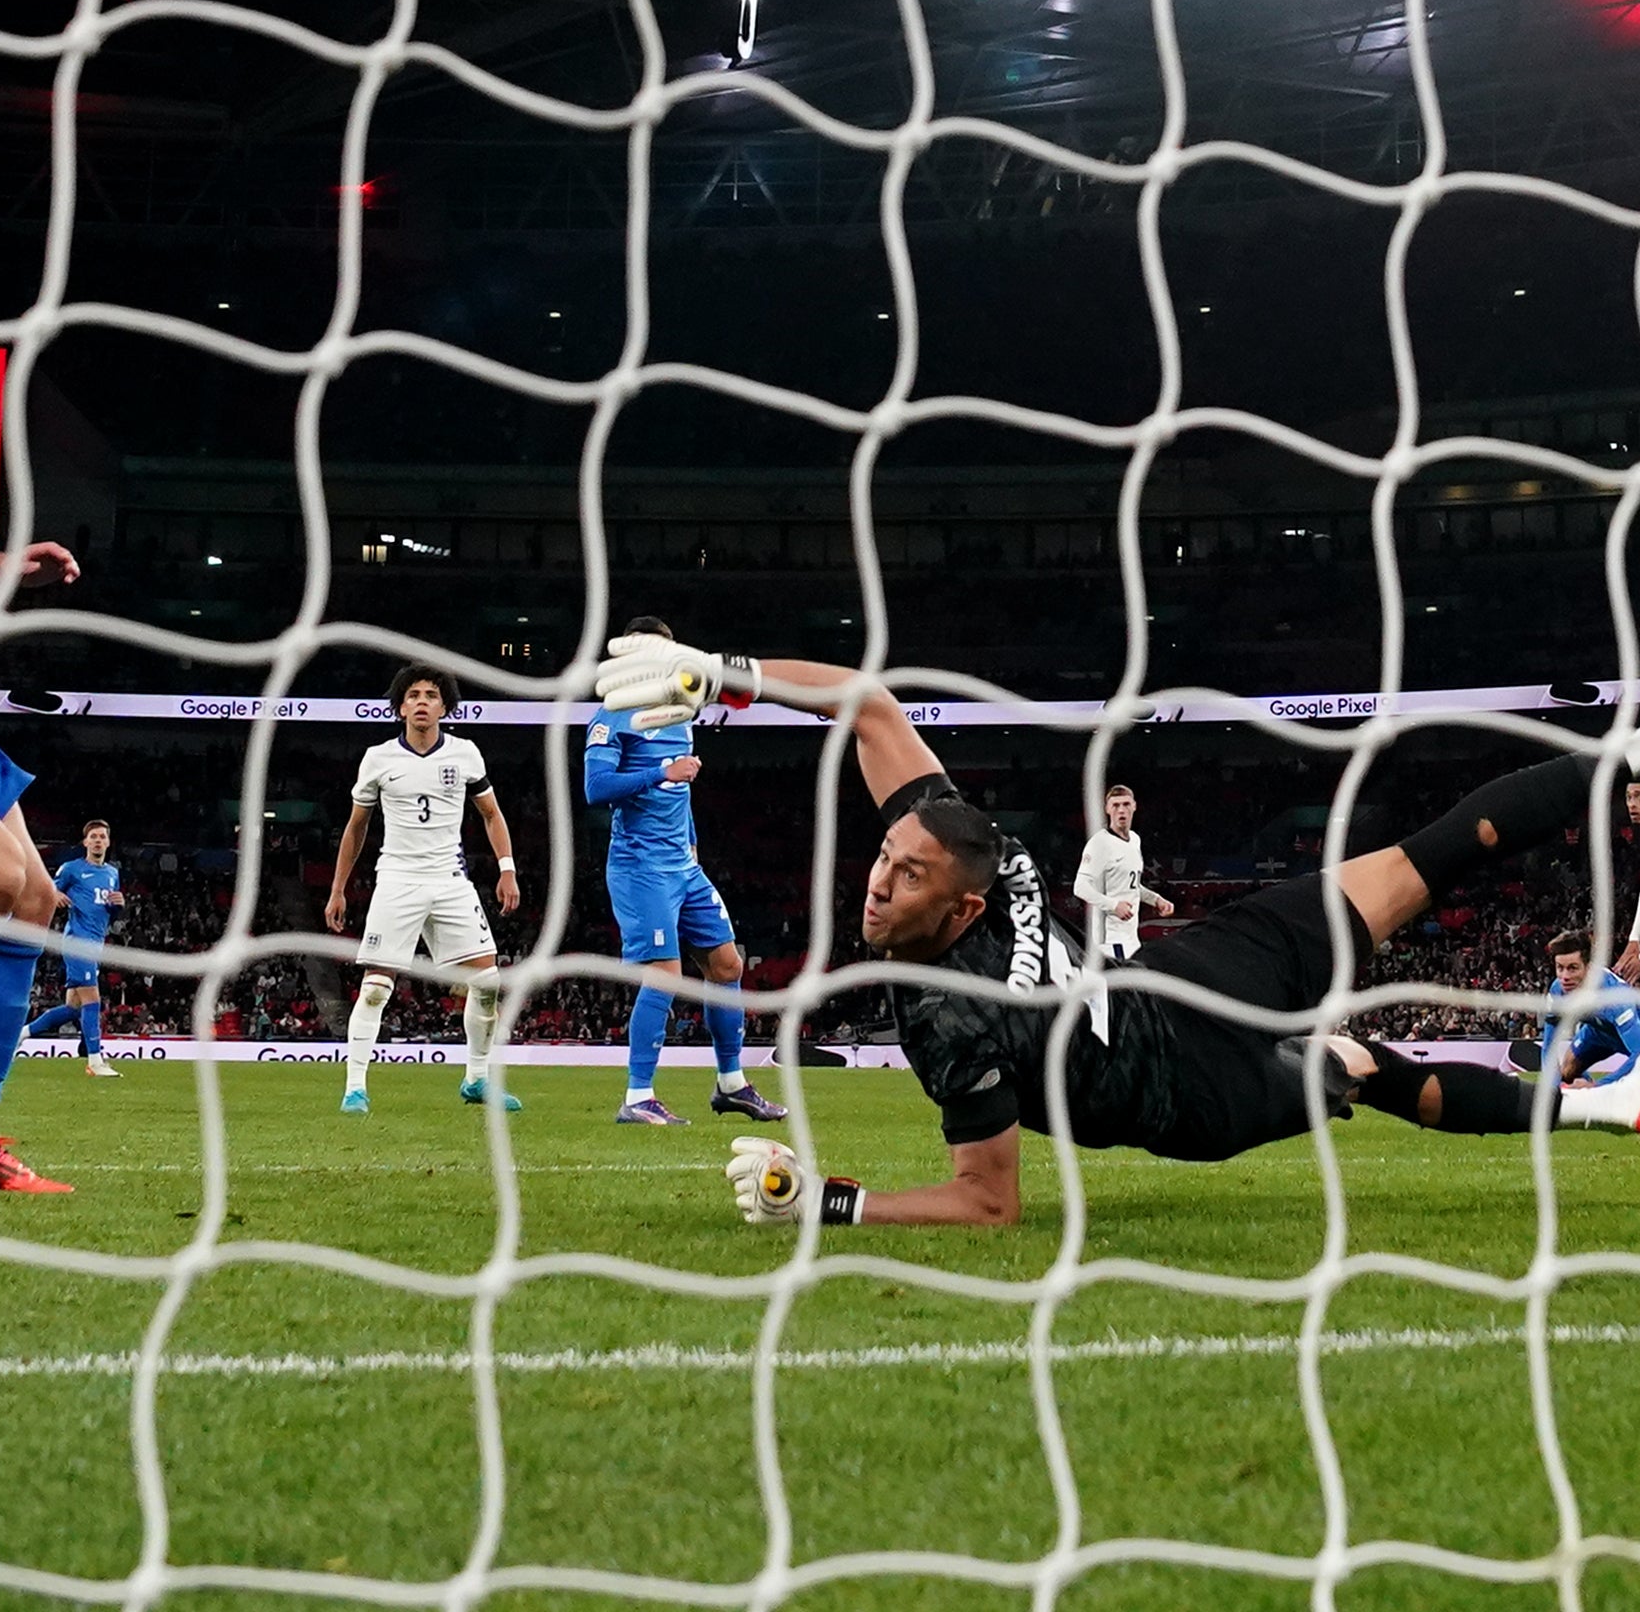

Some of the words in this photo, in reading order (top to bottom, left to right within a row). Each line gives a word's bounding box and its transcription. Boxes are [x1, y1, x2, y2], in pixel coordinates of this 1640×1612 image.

[180, 699, 246, 719] Google
[297, 702, 308, 717] 9
[355, 703, 396, 719] Goo
[473, 705, 483, 719] 9
[930, 707, 940, 721] 9
[1270, 700, 1333, 719] Google
[1338, 697, 1376, 713] Pixel
[417, 795, 431, 823] 3
[474, 905, 488, 931] 3
[998, 853, 1044, 997] ODYSSEAS
